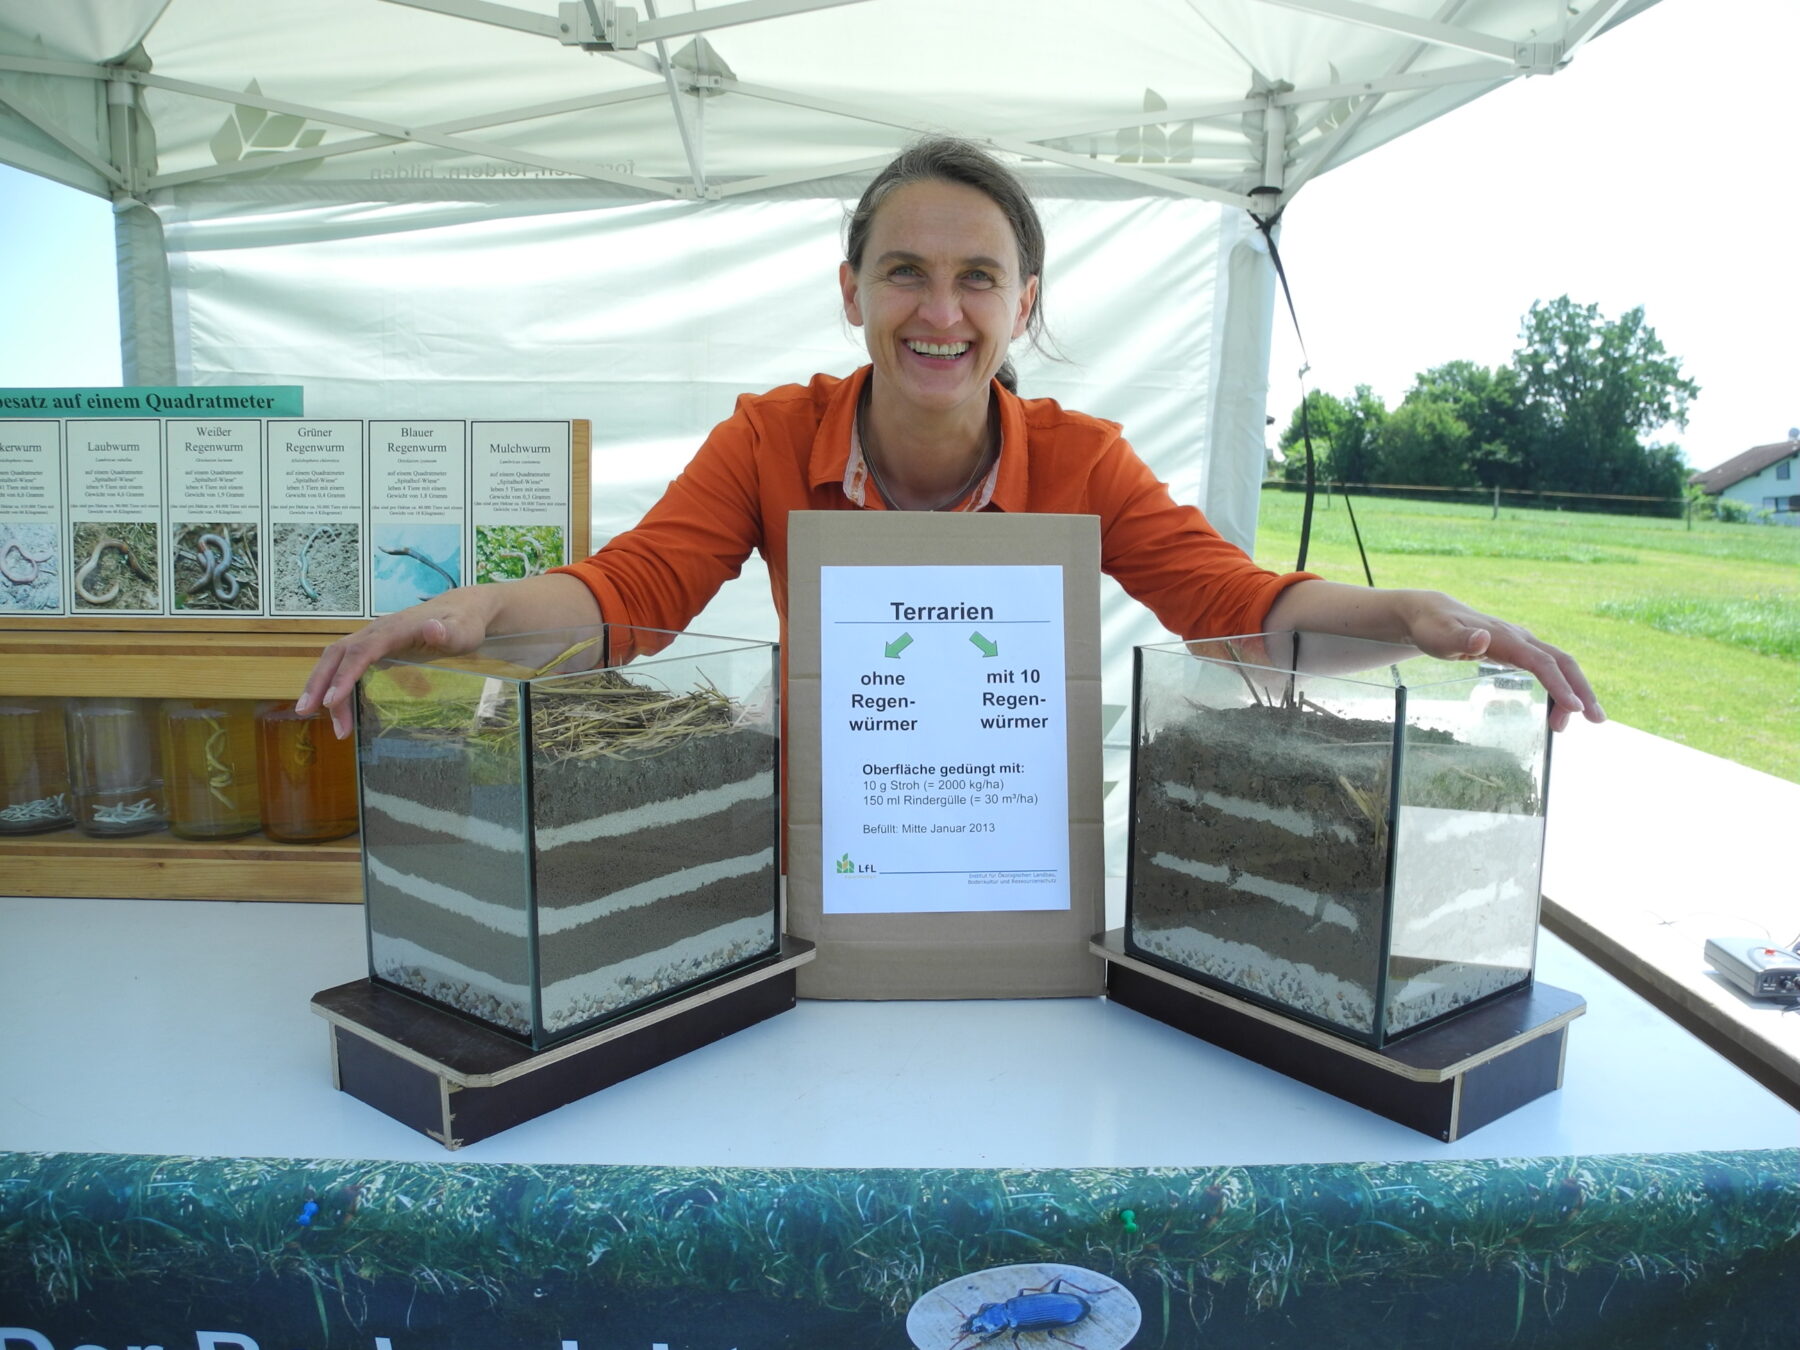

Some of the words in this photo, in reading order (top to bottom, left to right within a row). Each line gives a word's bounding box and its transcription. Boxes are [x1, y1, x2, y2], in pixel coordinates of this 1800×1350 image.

[52, 394, 82, 408] auf
[87, 394, 140, 408] einem
[146, 393, 275, 412] Quadratmeter
[197, 427, 232, 436] Weißer
[298, 427, 332, 437] Grüner
[401, 427, 434, 437] Blauer
[0, 442, 42, 452] kerwurm
[88, 442, 140, 452] Laubwurm
[185, 442, 243, 454] Regenwurm
[286, 442, 344, 454] Regenwurm
[388, 443, 446, 454] Regenwurm
[490, 444, 551, 454] Mulchwurm
[890, 602, 993, 620] Terrarien
[861, 672, 905, 685] ohne
[987, 670, 1014, 683] mit
[1021, 670, 1040, 683] 10
[852, 694, 915, 712] Regen-
[983, 692, 1046, 709] Regen-
[849, 717, 917, 731] würmer
[981, 715, 1048, 728] würmer
[863, 764, 935, 775] Oberfläche
[940, 764, 995, 776] gedüngt
[1000, 763, 1024, 774] mit:
[864, 780, 876, 791] 10
[879, 783, 887, 792] g
[890, 780, 920, 790] Stroh
[924, 780, 933, 791] (=
[938, 780, 966, 790] 2000
[970, 779, 1004, 792] kg/ha)
[864, 796, 884, 805] 150
[887, 796, 900, 805] ml
[904, 795, 966, 807] Rindergülle
[970, 795, 981, 806] (=
[985, 794, 998, 804] 30
[1002, 793, 1038, 806] m³/ha)
[863, 824, 898, 834] Befüllt:
[902, 824, 927, 833] Mitte
[931, 824, 965, 833] Januar
[970, 823, 995, 833] 2013
[859, 864, 877, 872] LfL
